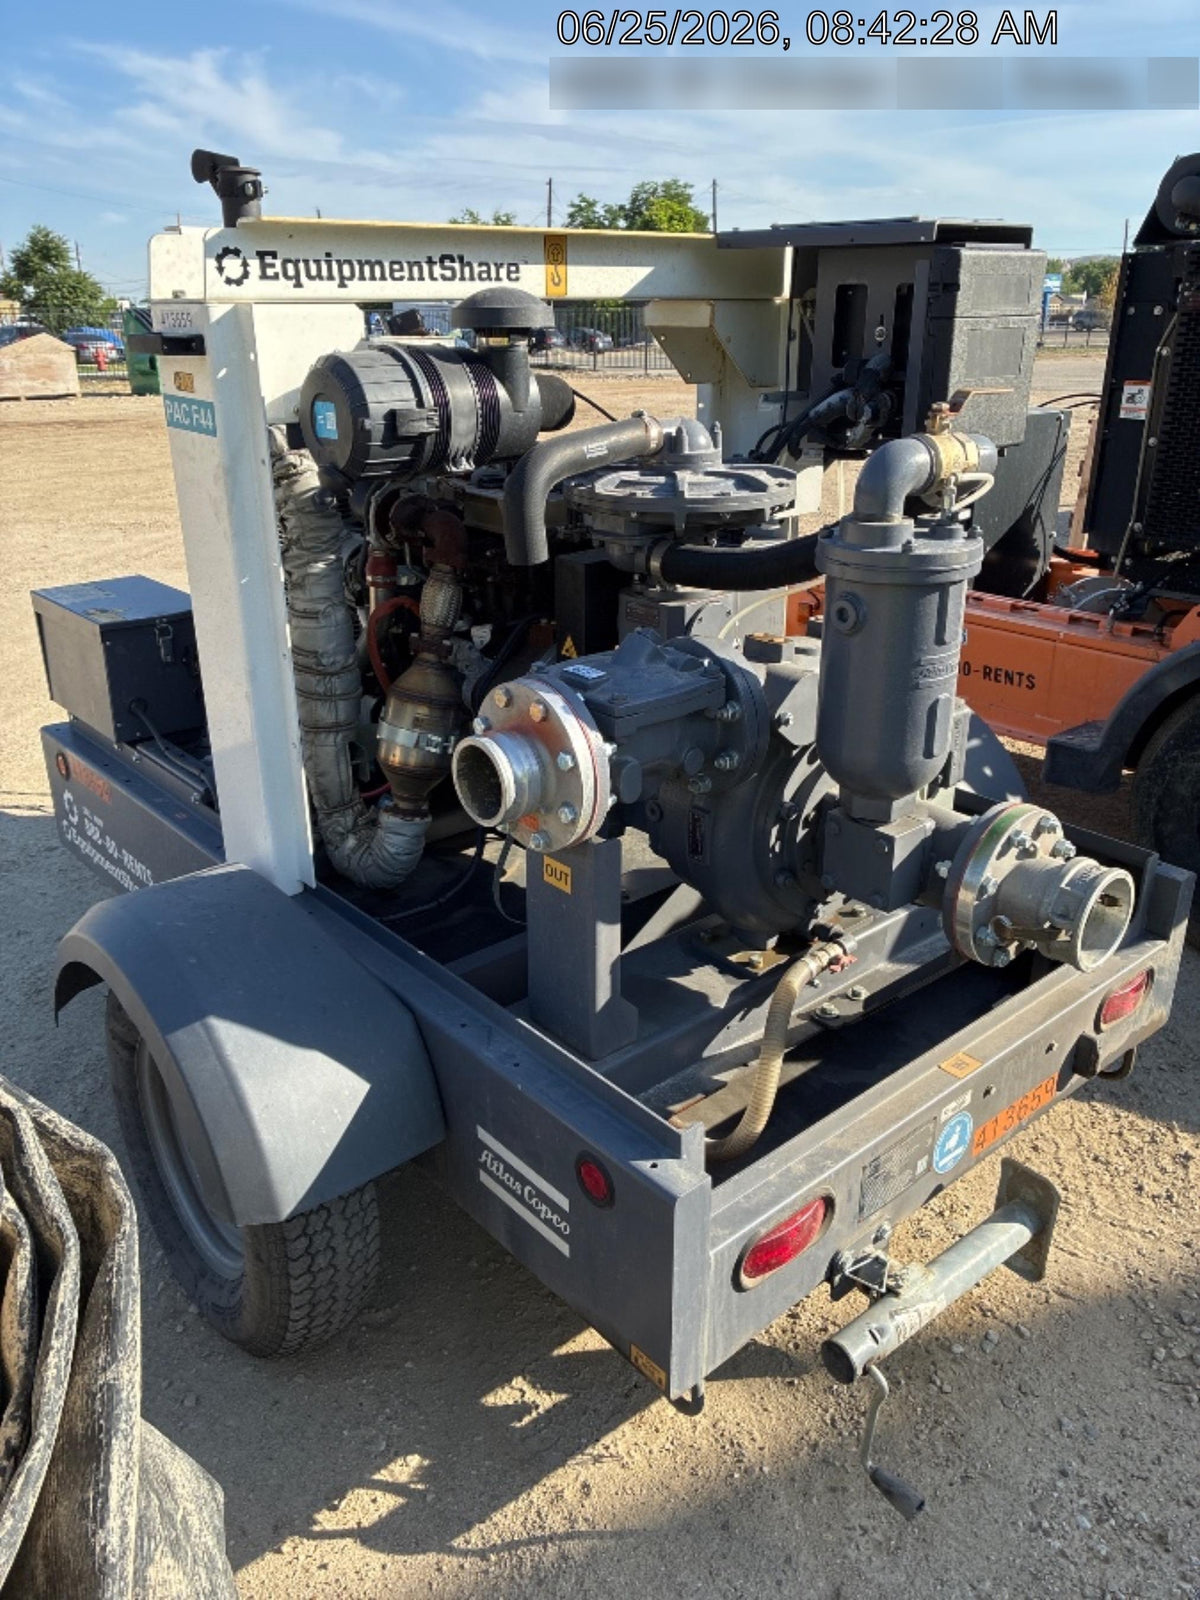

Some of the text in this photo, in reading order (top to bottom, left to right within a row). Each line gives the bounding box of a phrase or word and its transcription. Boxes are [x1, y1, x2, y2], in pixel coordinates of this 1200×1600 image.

[256, 250, 521, 287] EquipmentShare
[165, 400, 214, 429] PAC F44
[958, 661, 1036, 690] 0-RENTS
[545, 863, 569, 886] OUT
[478, 1150, 571, 1235] Atlas Copco
